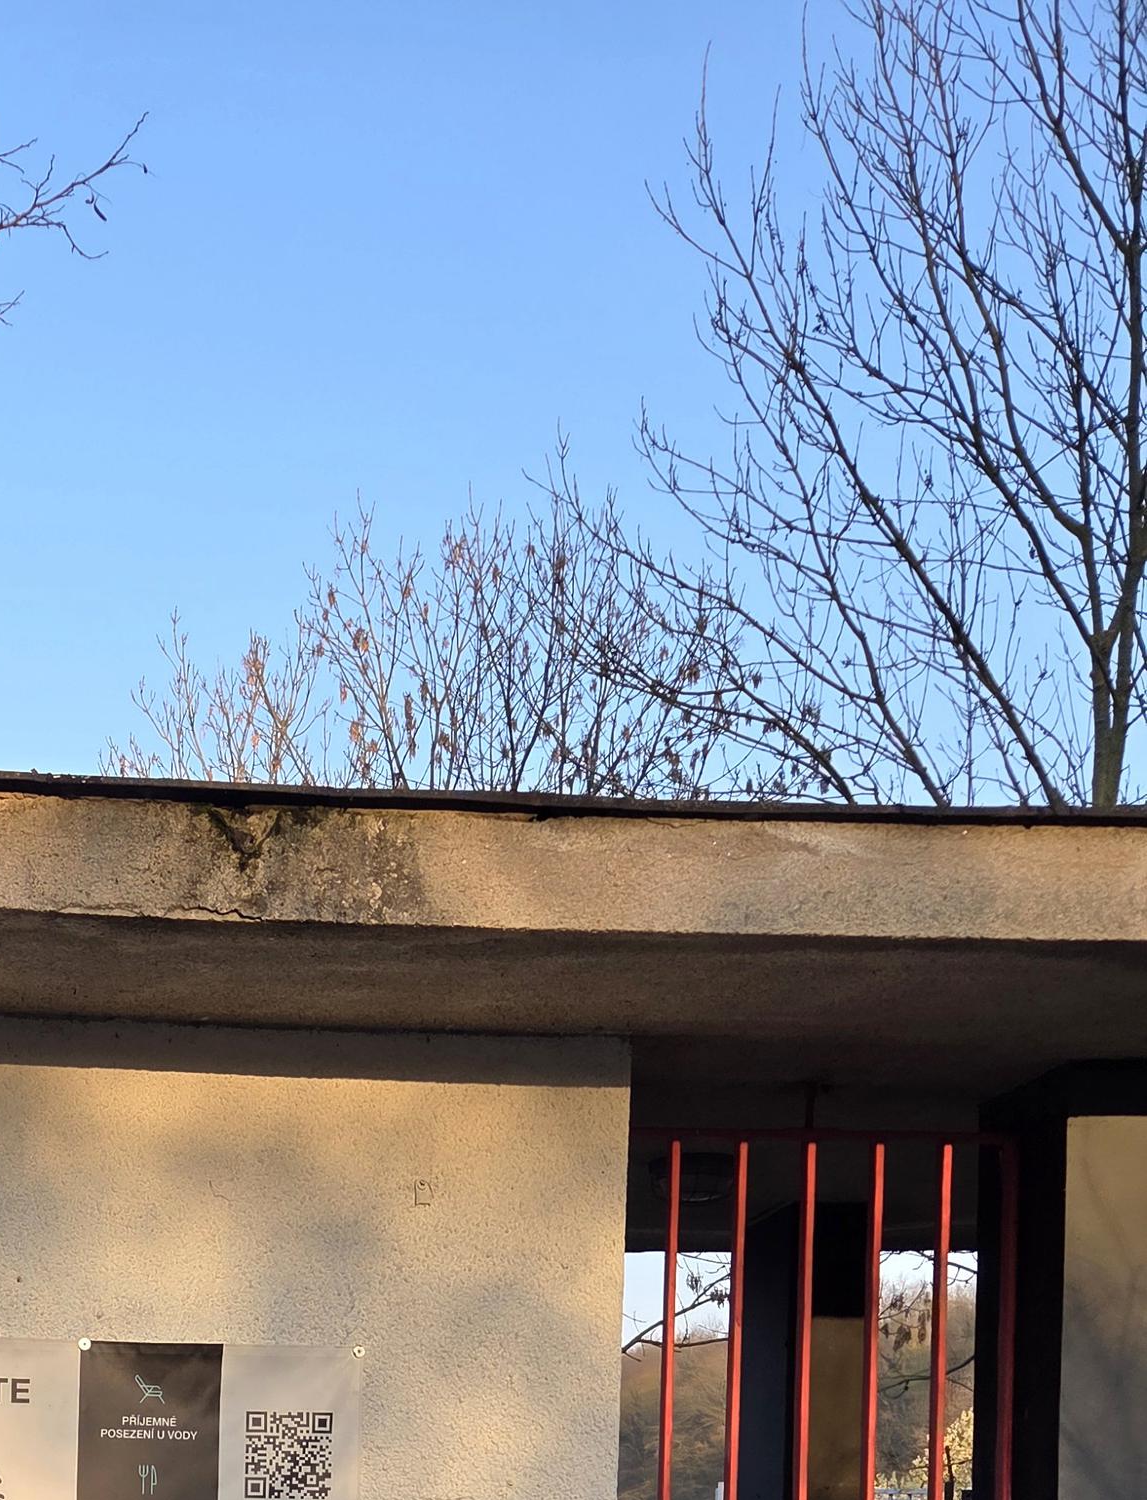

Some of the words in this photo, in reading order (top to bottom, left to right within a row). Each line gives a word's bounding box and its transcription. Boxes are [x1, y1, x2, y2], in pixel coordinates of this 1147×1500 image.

[100, 1428, 155, 1440] POSEZENÍ
[157, 1430, 165, 1440] U
[167, 1430, 198, 1440] VODY
